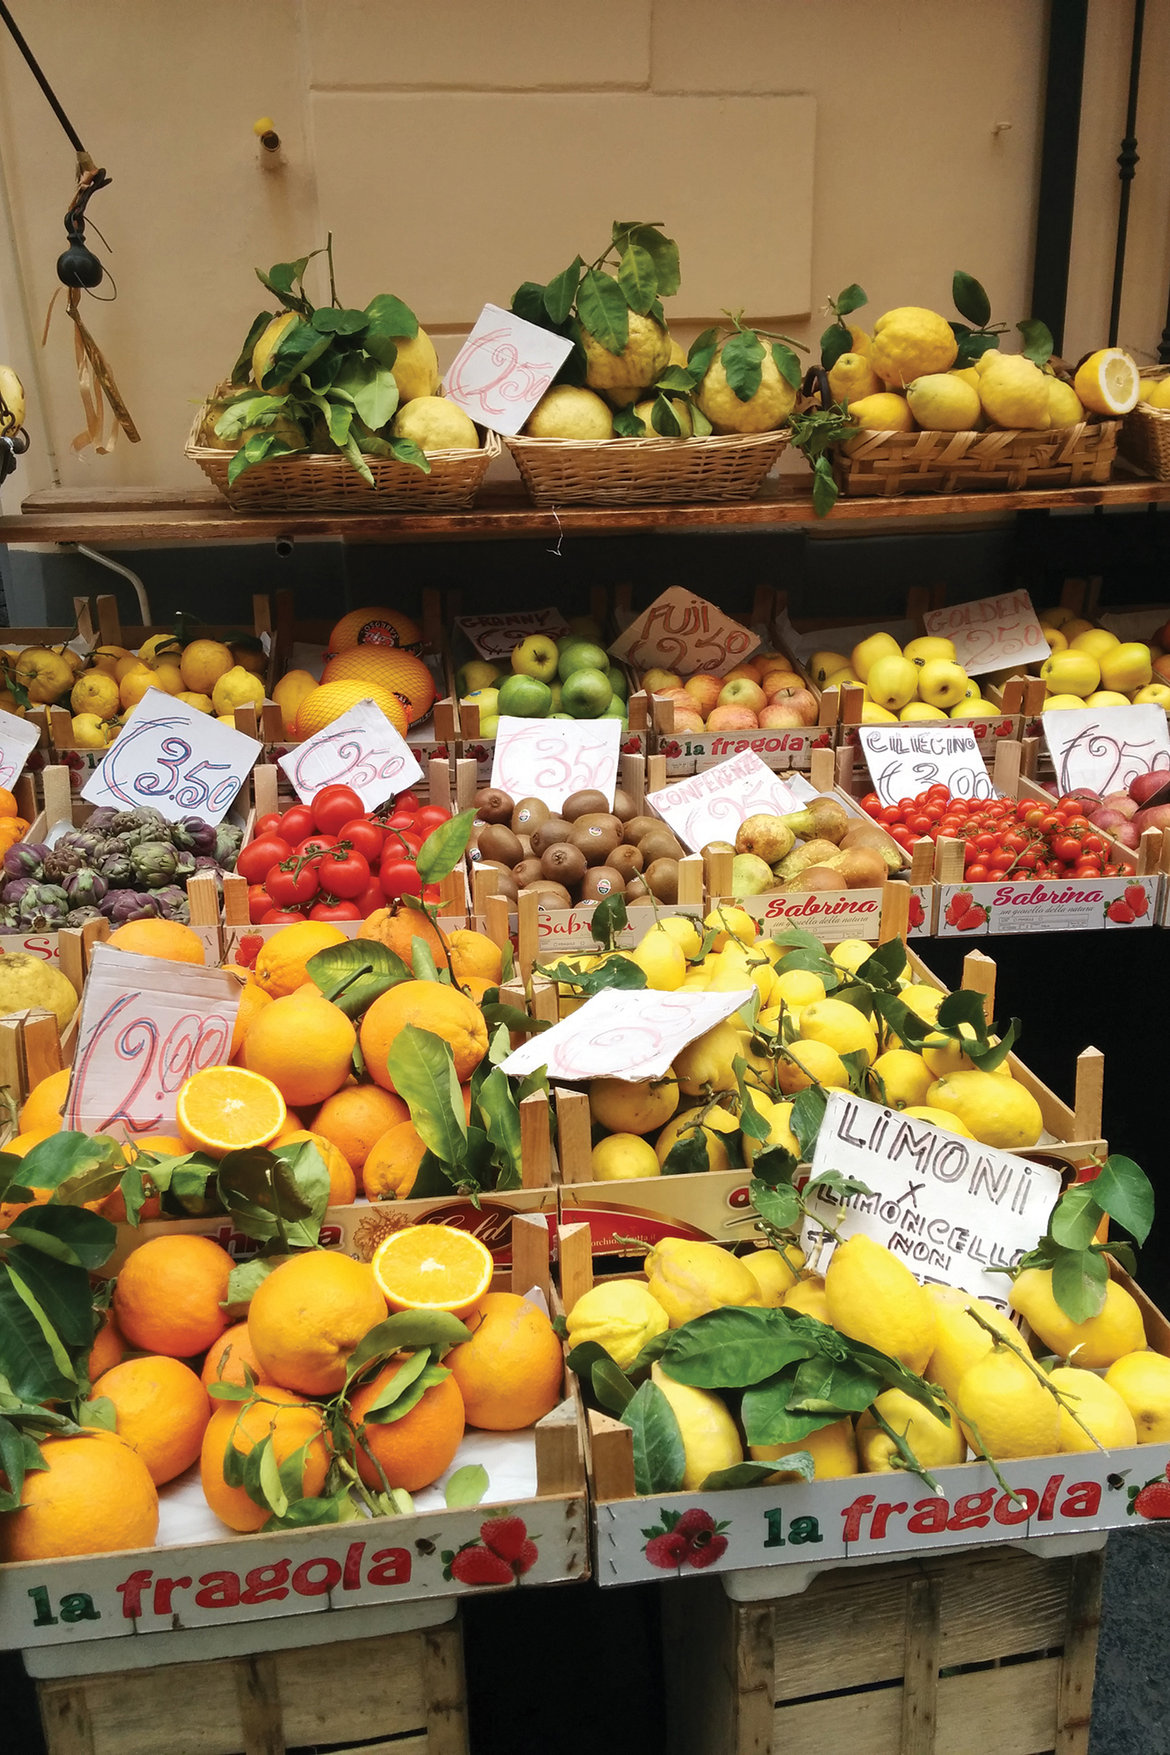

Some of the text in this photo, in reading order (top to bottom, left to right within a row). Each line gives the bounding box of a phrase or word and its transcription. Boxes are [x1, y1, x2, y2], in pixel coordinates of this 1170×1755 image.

[460, 610, 551, 628] GRANNY
[926, 591, 1032, 633] GOLDEN
[684, 733, 804, 757] la fragola
[866, 730, 976, 756] CILIEGINO
[765, 895, 879, 918] Sabrina
[991, 883, 1105, 906] Sabrina
[887, 1231, 952, 1271] NON
[763, 1473, 1103, 1548] la fragola
[27, 1541, 413, 1627] la fragola
